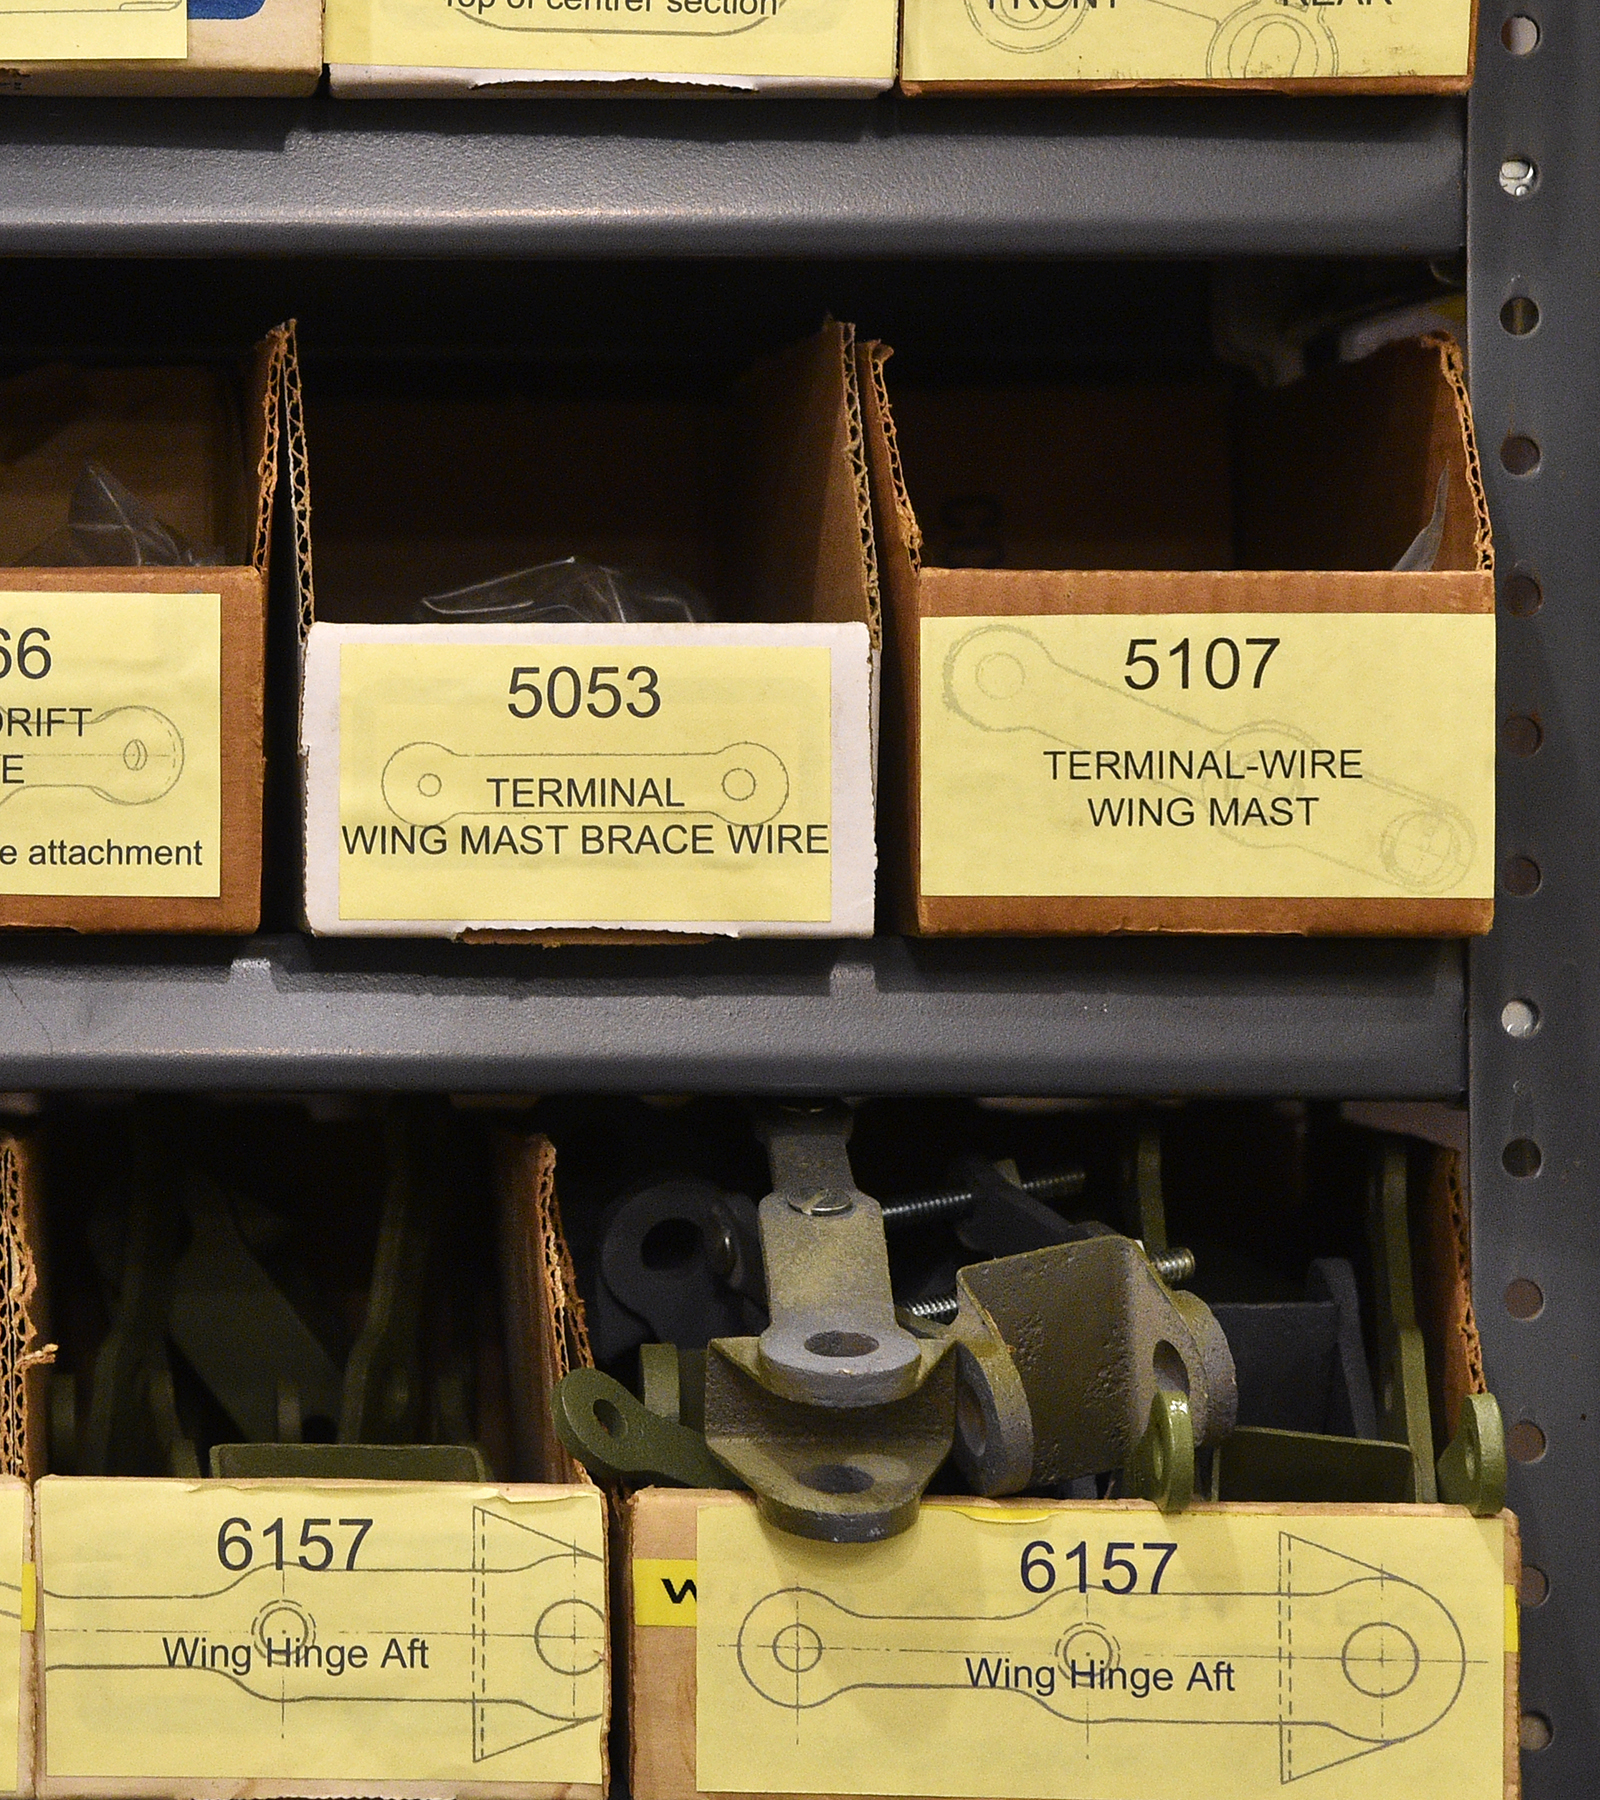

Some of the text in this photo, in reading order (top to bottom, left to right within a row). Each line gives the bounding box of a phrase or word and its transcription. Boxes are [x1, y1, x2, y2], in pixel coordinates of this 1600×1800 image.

[1124, 637, 1281, 691] 5107
[508, 665, 661, 719] 5053
[1043, 749, 1363, 780] TERMINAL-WIRE
[486, 777, 685, 808] TERMINAL
[1087, 797, 1319, 827] WING MAST
[28, 838, 203, 866] attachment
[341, 824, 829, 855] WING MAST BRACE WIRE
[217, 1517, 373, 1572] 6157
[1020, 1540, 1178, 1595] 6157
[162, 1637, 429, 1677] Wing Hinge Aft
[965, 1657, 1236, 1698] Wing Hinge Aft
